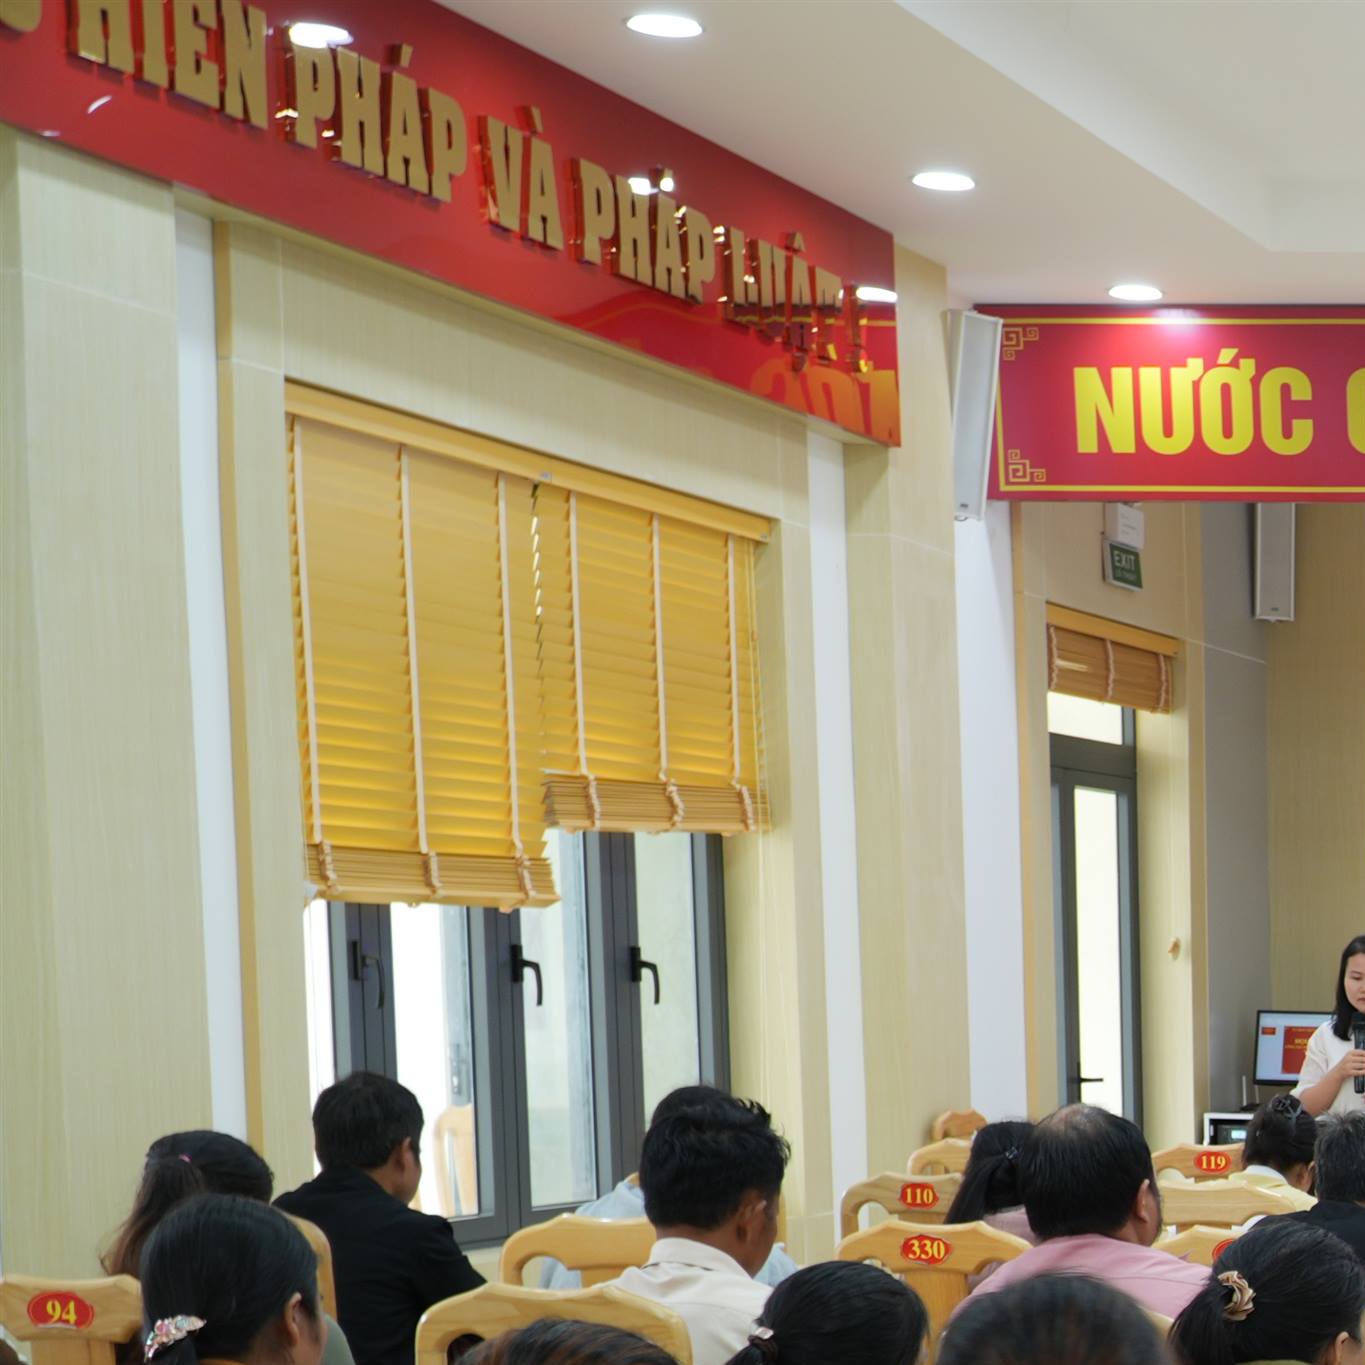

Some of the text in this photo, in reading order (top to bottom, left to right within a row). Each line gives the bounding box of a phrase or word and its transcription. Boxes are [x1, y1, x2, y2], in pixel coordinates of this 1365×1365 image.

[292, 43, 467, 203] PHÁP
[486, 106, 564, 251] VÀ
[579, 157, 716, 304] PHÁP
[1074, 347, 1314, 455] NƯỚC
[1202, 1155, 1226, 1169] 119
[906, 1188, 933, 1204] 110
[908, 1239, 945, 1259] 330
[47, 1300, 77, 1324] 94
